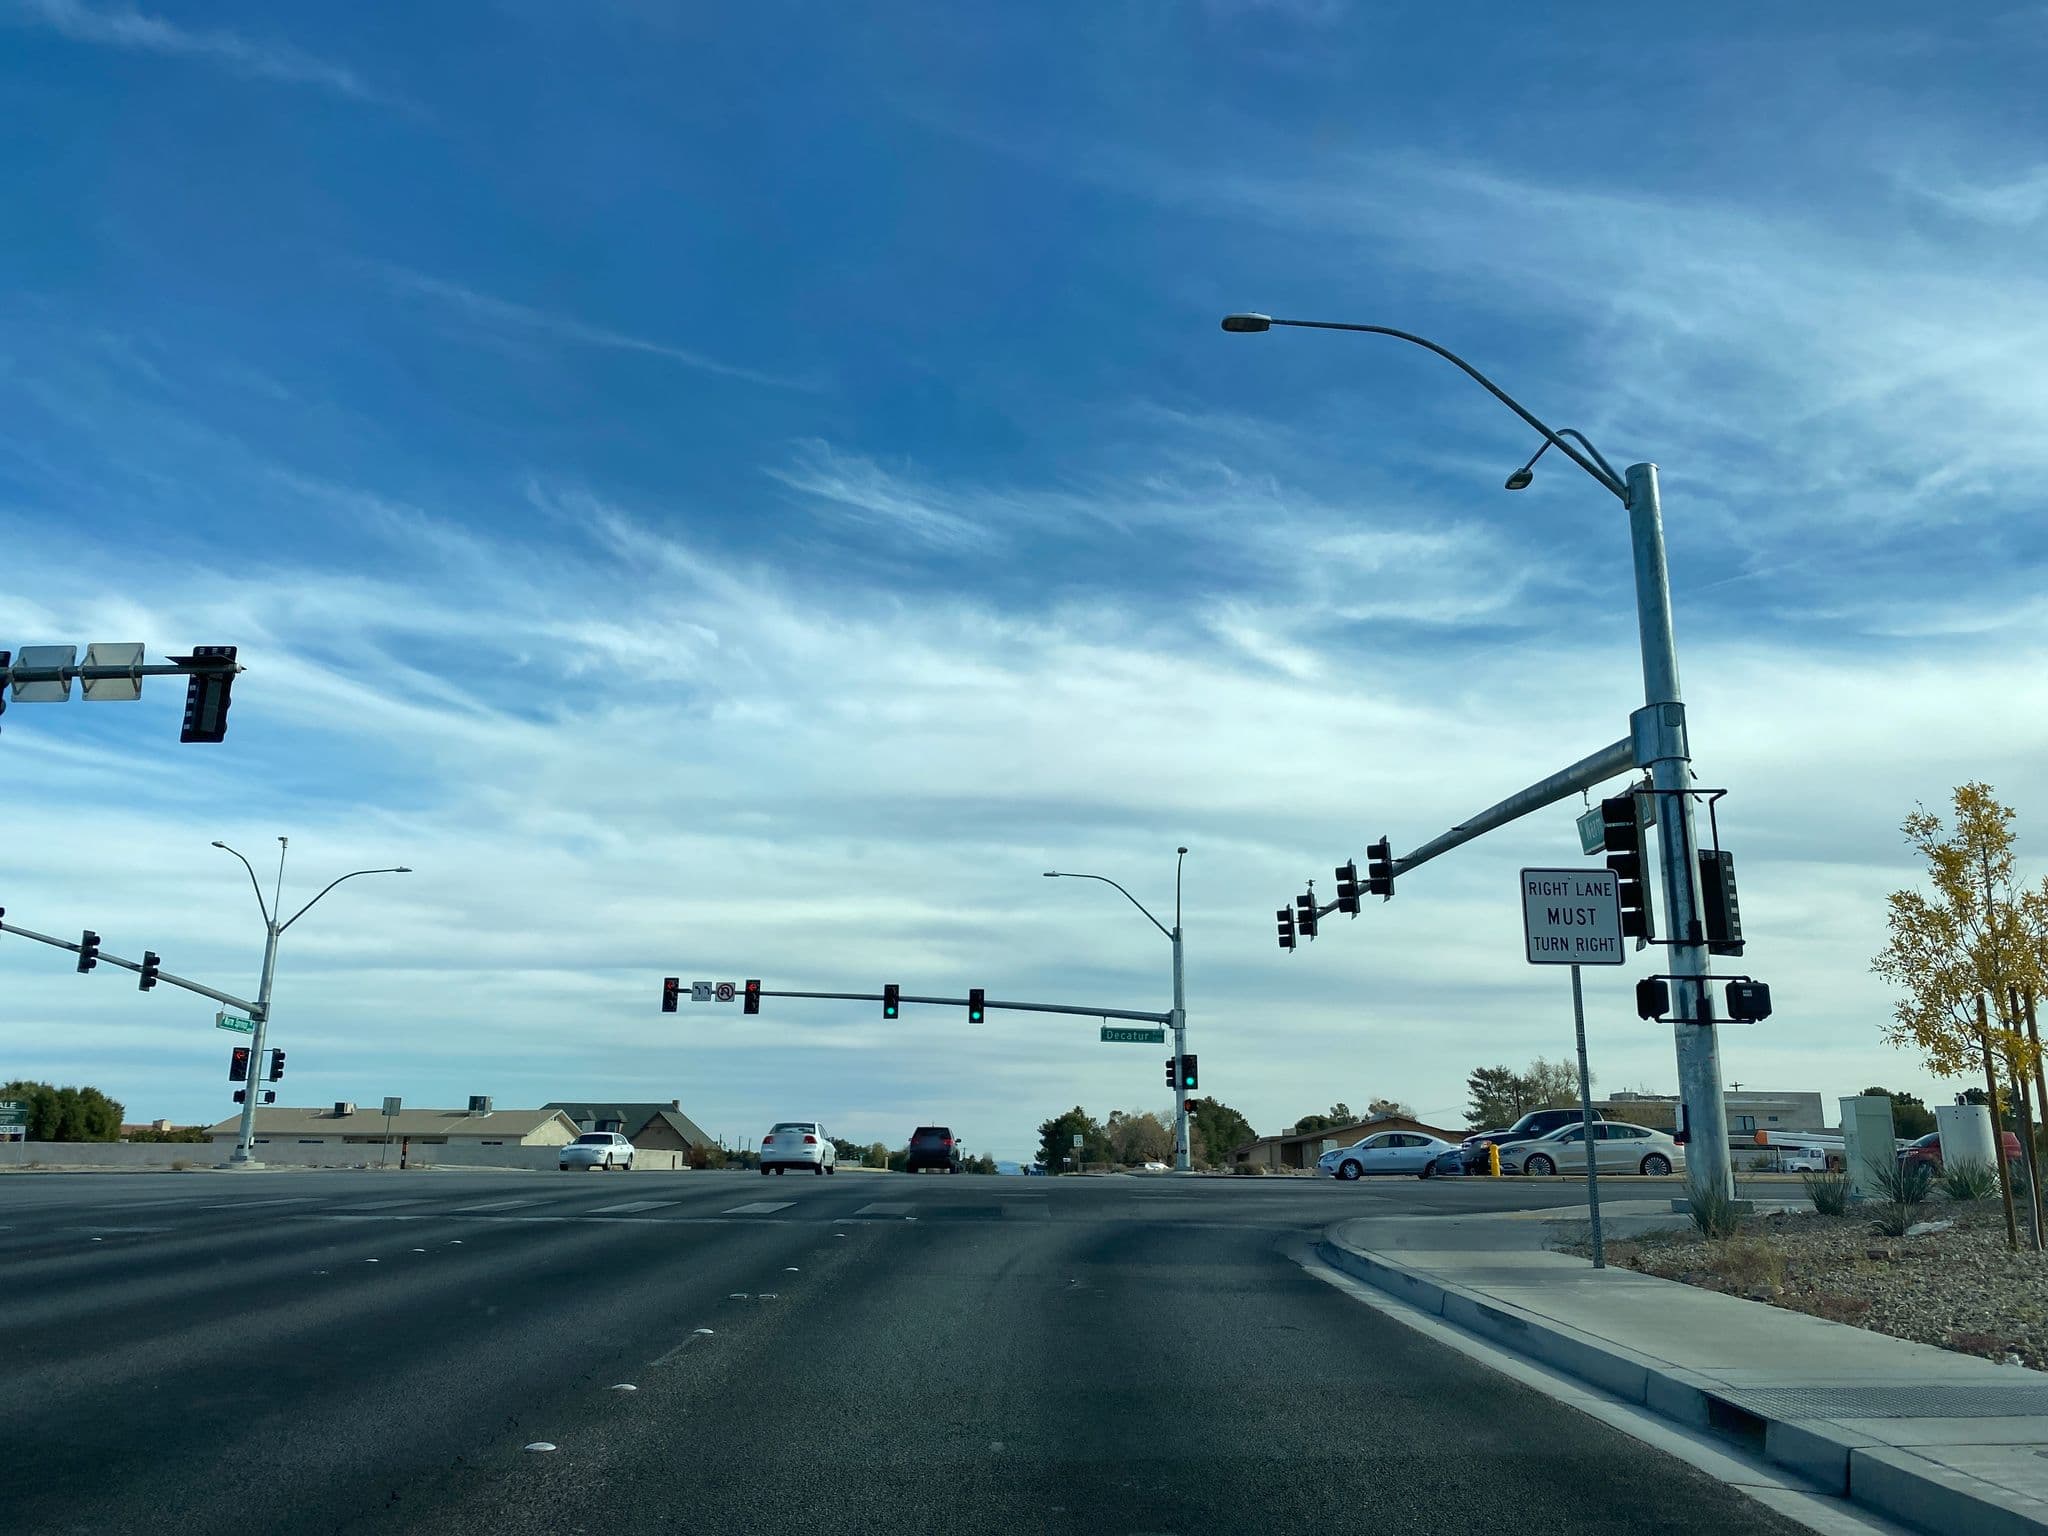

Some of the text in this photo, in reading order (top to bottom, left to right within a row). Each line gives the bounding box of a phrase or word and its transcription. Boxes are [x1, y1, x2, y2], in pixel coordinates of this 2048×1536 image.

[1528, 881, 1613, 897] RIGHT LANE
[1547, 907, 1596, 926] MUST
[1533, 936, 1616, 952] TURN RIGHT
[1106, 1030, 1150, 1041] Decatur
